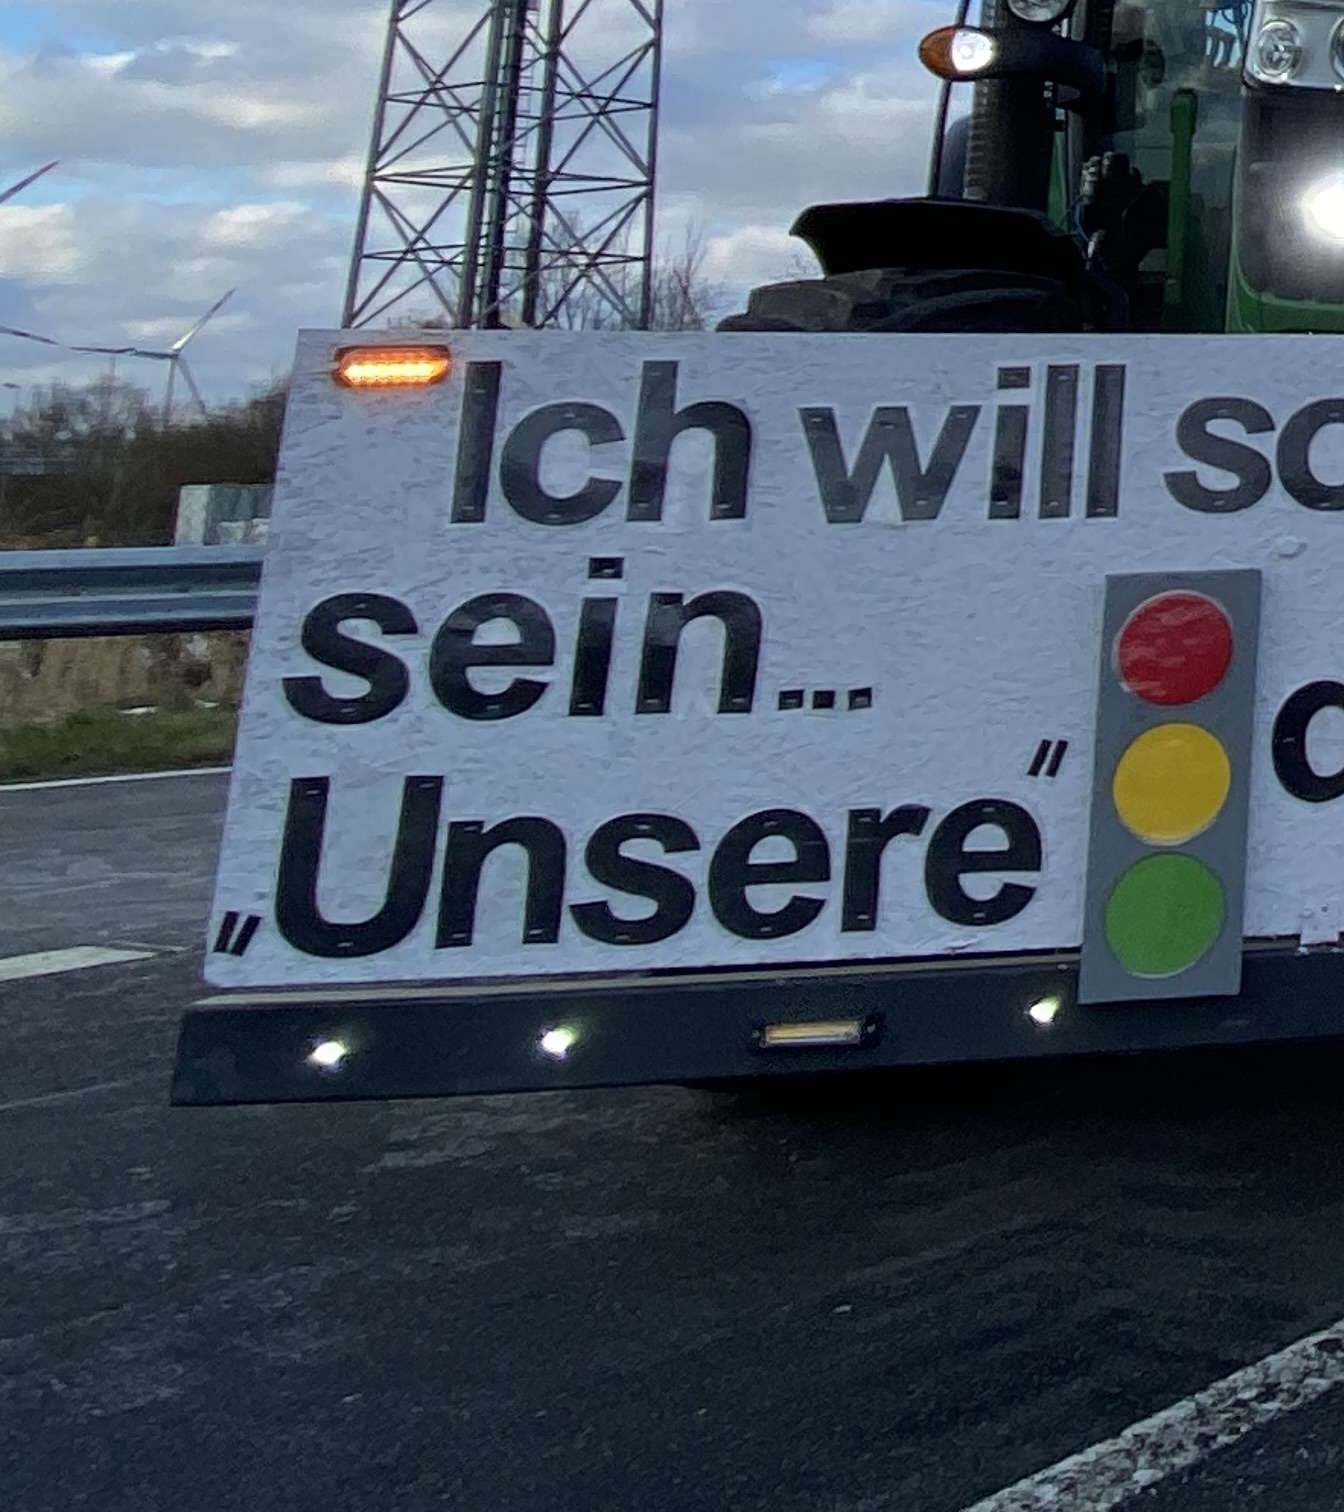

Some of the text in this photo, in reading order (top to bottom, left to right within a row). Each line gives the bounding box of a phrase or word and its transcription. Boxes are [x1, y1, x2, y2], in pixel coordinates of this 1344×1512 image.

[449, 359, 752, 526] Ich
[799, 362, 1127, 526] will
[282, 556, 873, 725] sein...
